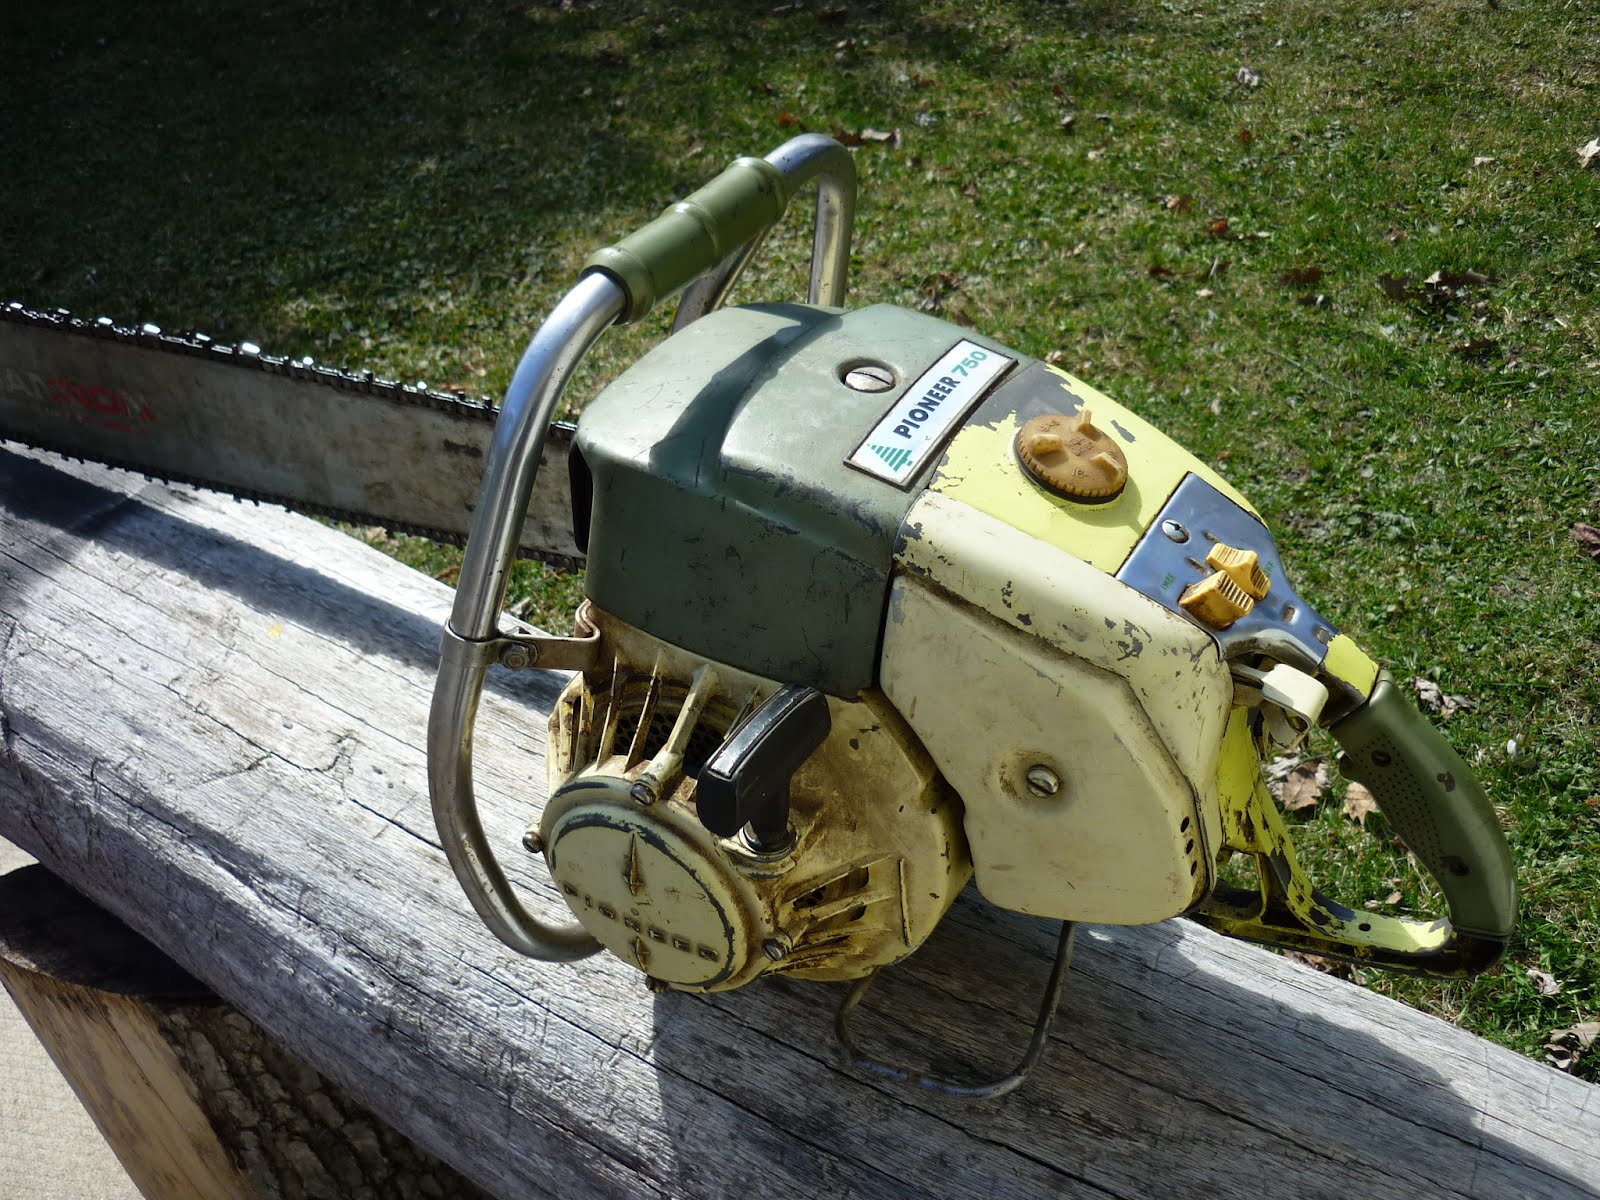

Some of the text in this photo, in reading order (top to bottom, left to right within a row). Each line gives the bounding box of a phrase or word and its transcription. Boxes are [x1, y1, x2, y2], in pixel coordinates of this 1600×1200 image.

[0, 367, 155, 423] ANNON
[893, 350, 988, 440] PIONEER 750
[563, 881, 721, 963] PIONEER
